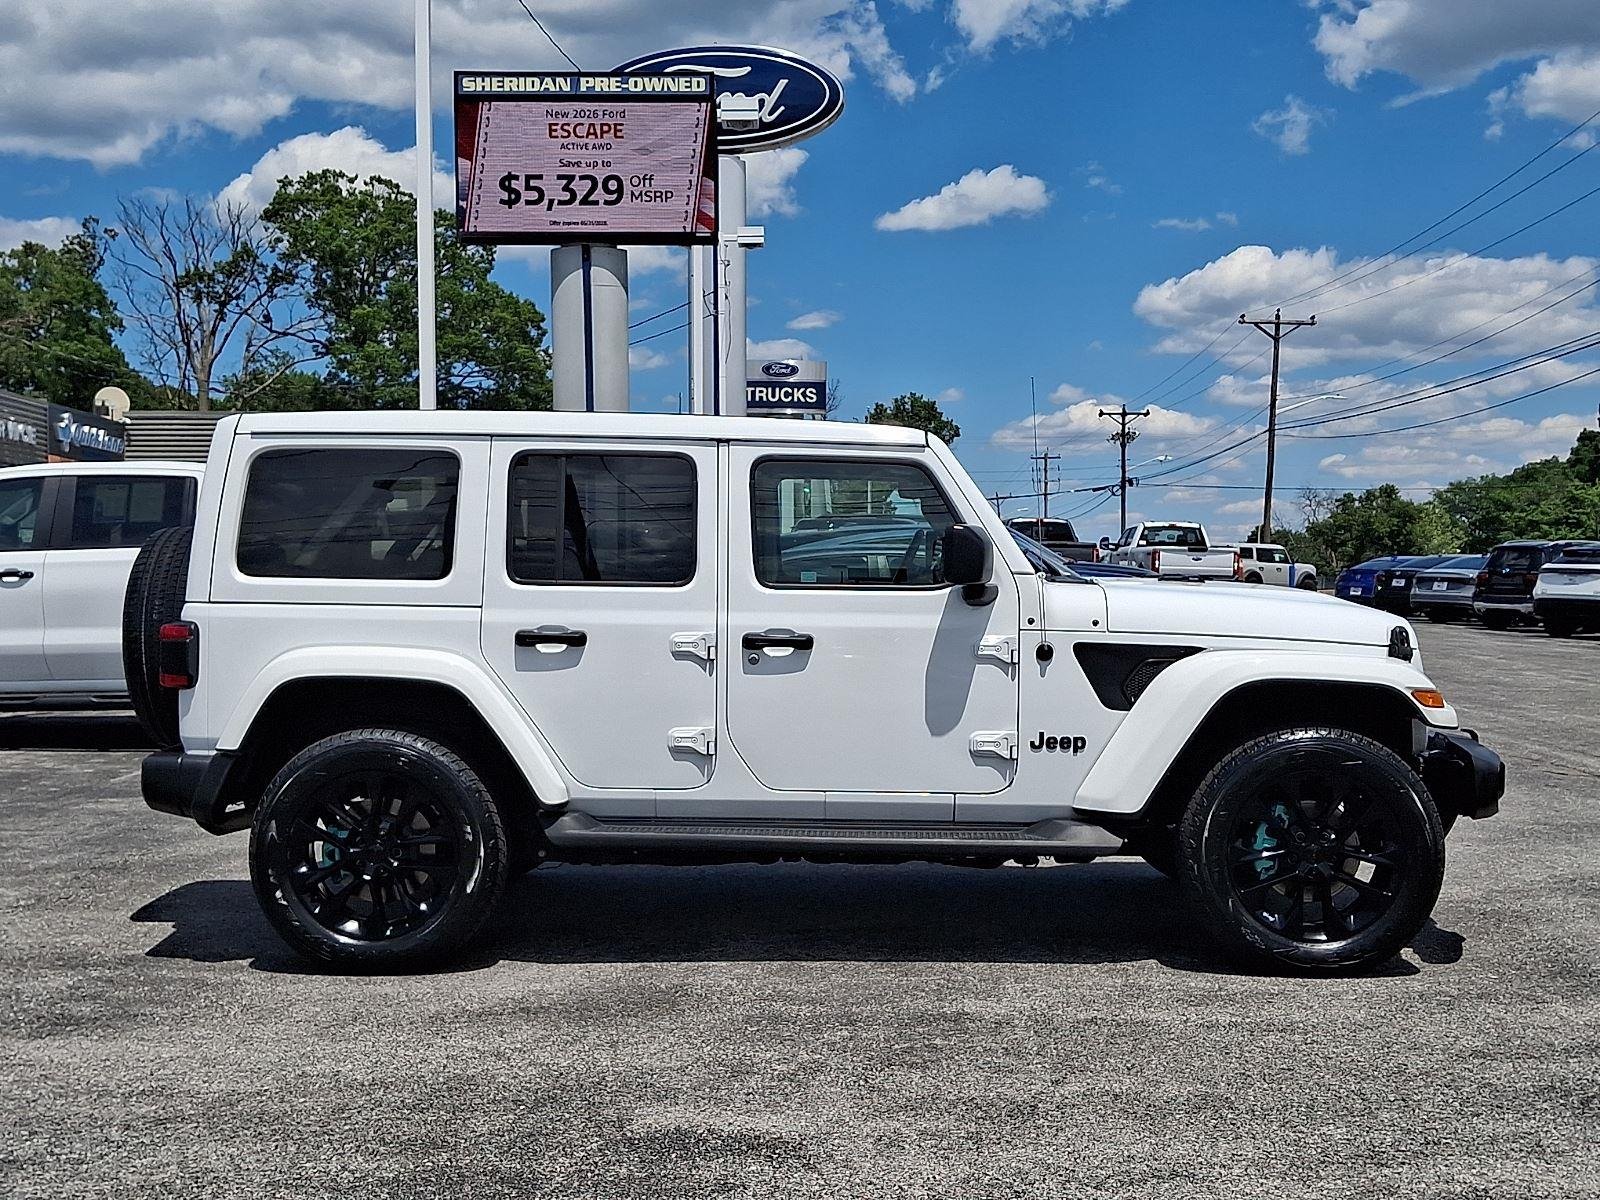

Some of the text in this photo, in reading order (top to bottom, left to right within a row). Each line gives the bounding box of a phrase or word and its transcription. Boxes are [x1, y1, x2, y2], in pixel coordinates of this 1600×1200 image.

[462, 76, 706, 92] SHERIDAN PRE-OWNED
[545, 109, 626, 118] New 2026 Ford
[548, 122, 625, 139] ESCAPE
[560, 142, 612, 150] ACTIVE AWD
[558, 158, 612, 169] Save up to
[629, 174, 655, 188] Off
[498, 171, 625, 212] $5,329
[630, 190, 674, 203] MSRP
[769, 364, 793, 375] Ford
[746, 387, 818, 403] TRUCKS
[1029, 731, 1087, 754] Jeep
